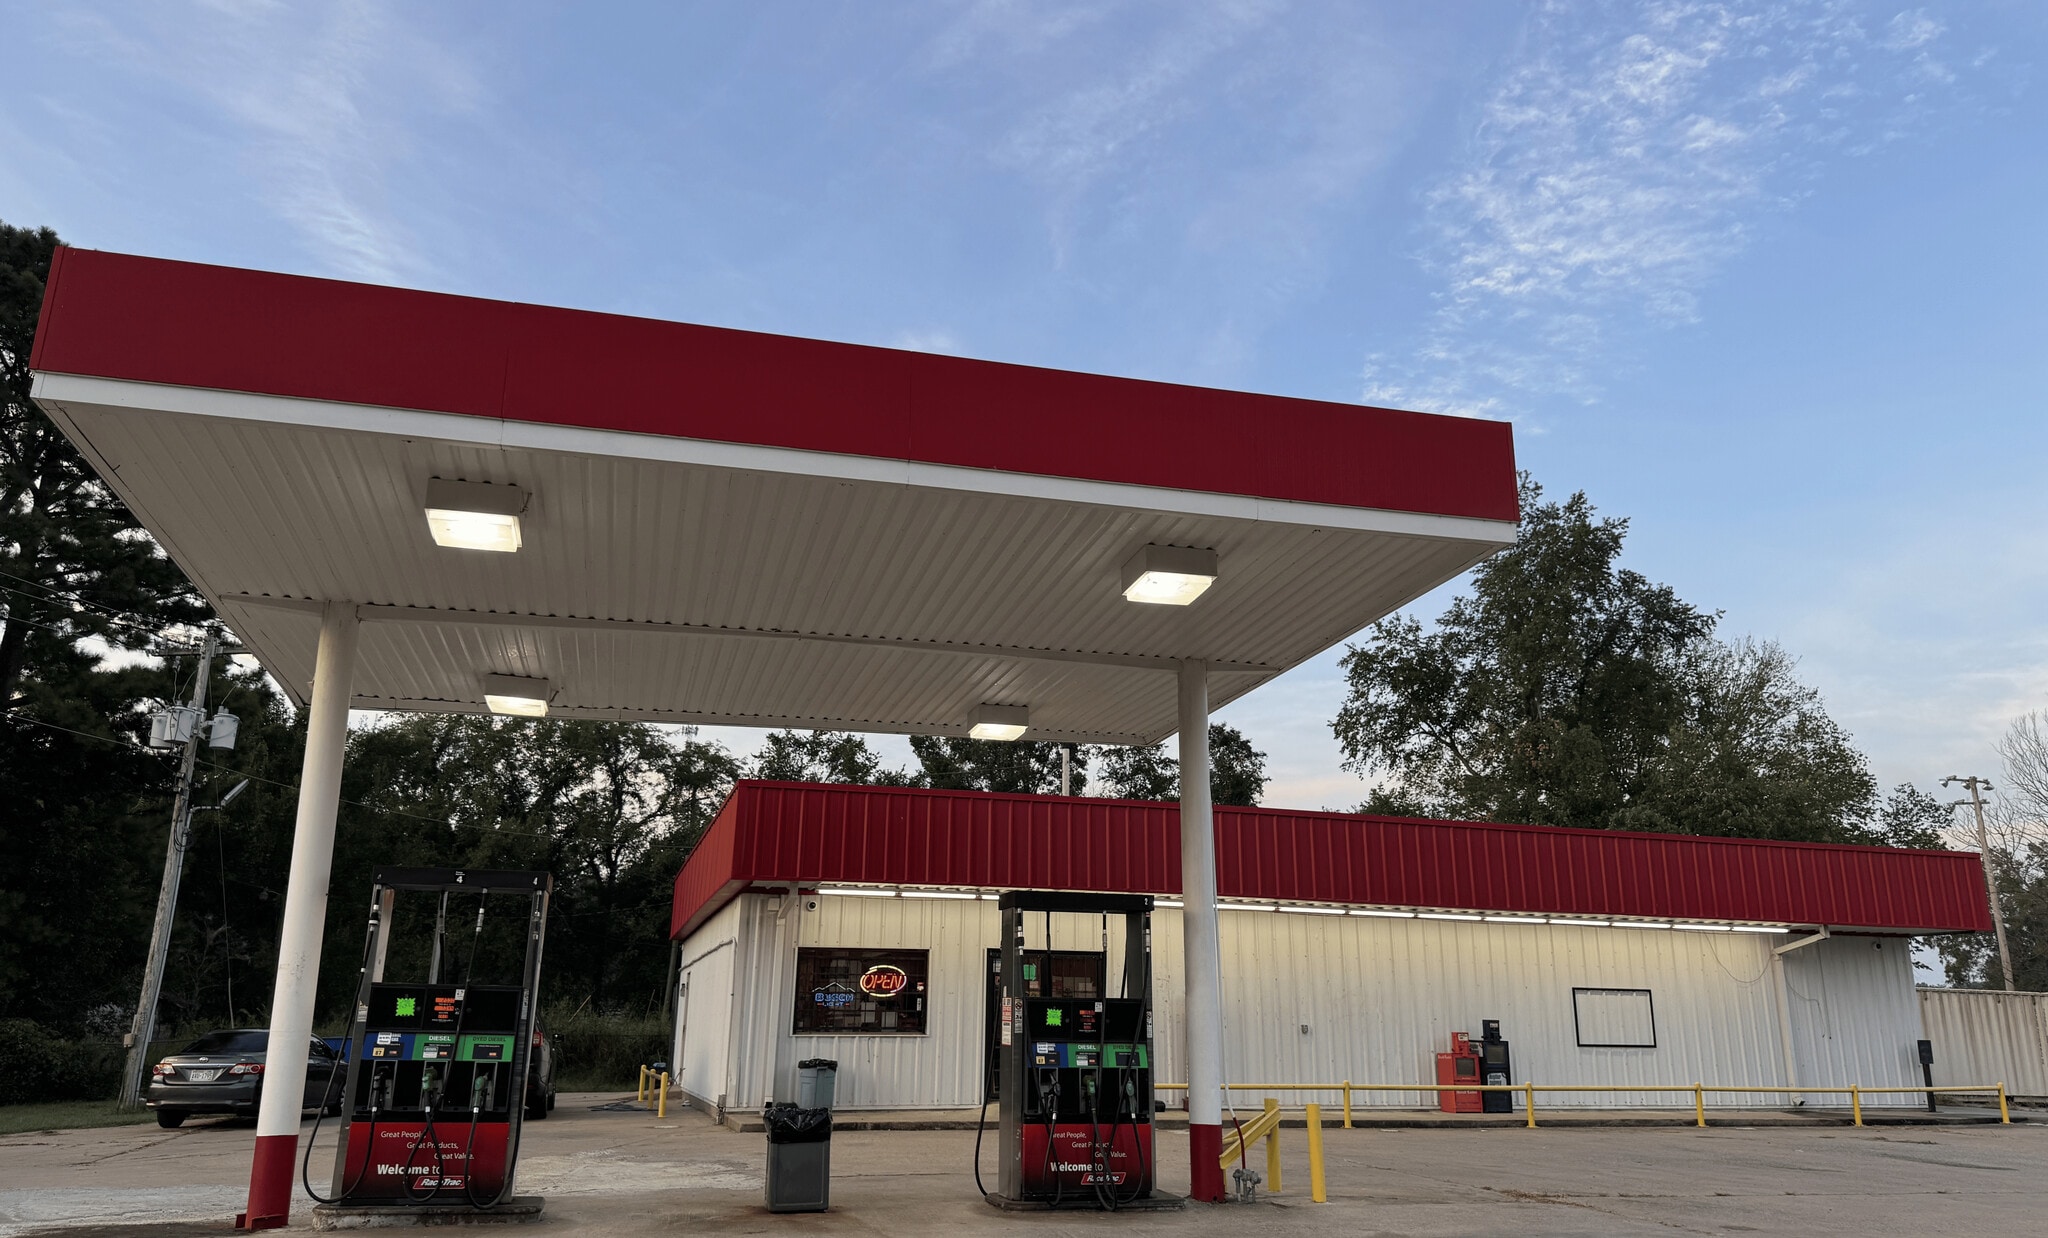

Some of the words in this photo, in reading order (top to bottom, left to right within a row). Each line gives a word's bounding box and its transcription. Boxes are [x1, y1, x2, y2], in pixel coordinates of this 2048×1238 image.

[533, 877, 538, 886] 4
[1144, 897, 1149, 906] 2
[862, 974, 903, 989] OPEN
[401, 1131, 426, 1140] Peopl,
[406, 1141, 426, 1149] Grat
[426, 1141, 459, 1150] Prducts,
[1071, 1141, 1087, 1149] Great
[434, 1152, 453, 1160] Geat
[431, 1165, 441, 1175] to
[1050, 1161, 1093, 1172] Welcome
[1094, 1162, 1104, 1172] to
[420, 1178, 462, 1187] RacTrac
